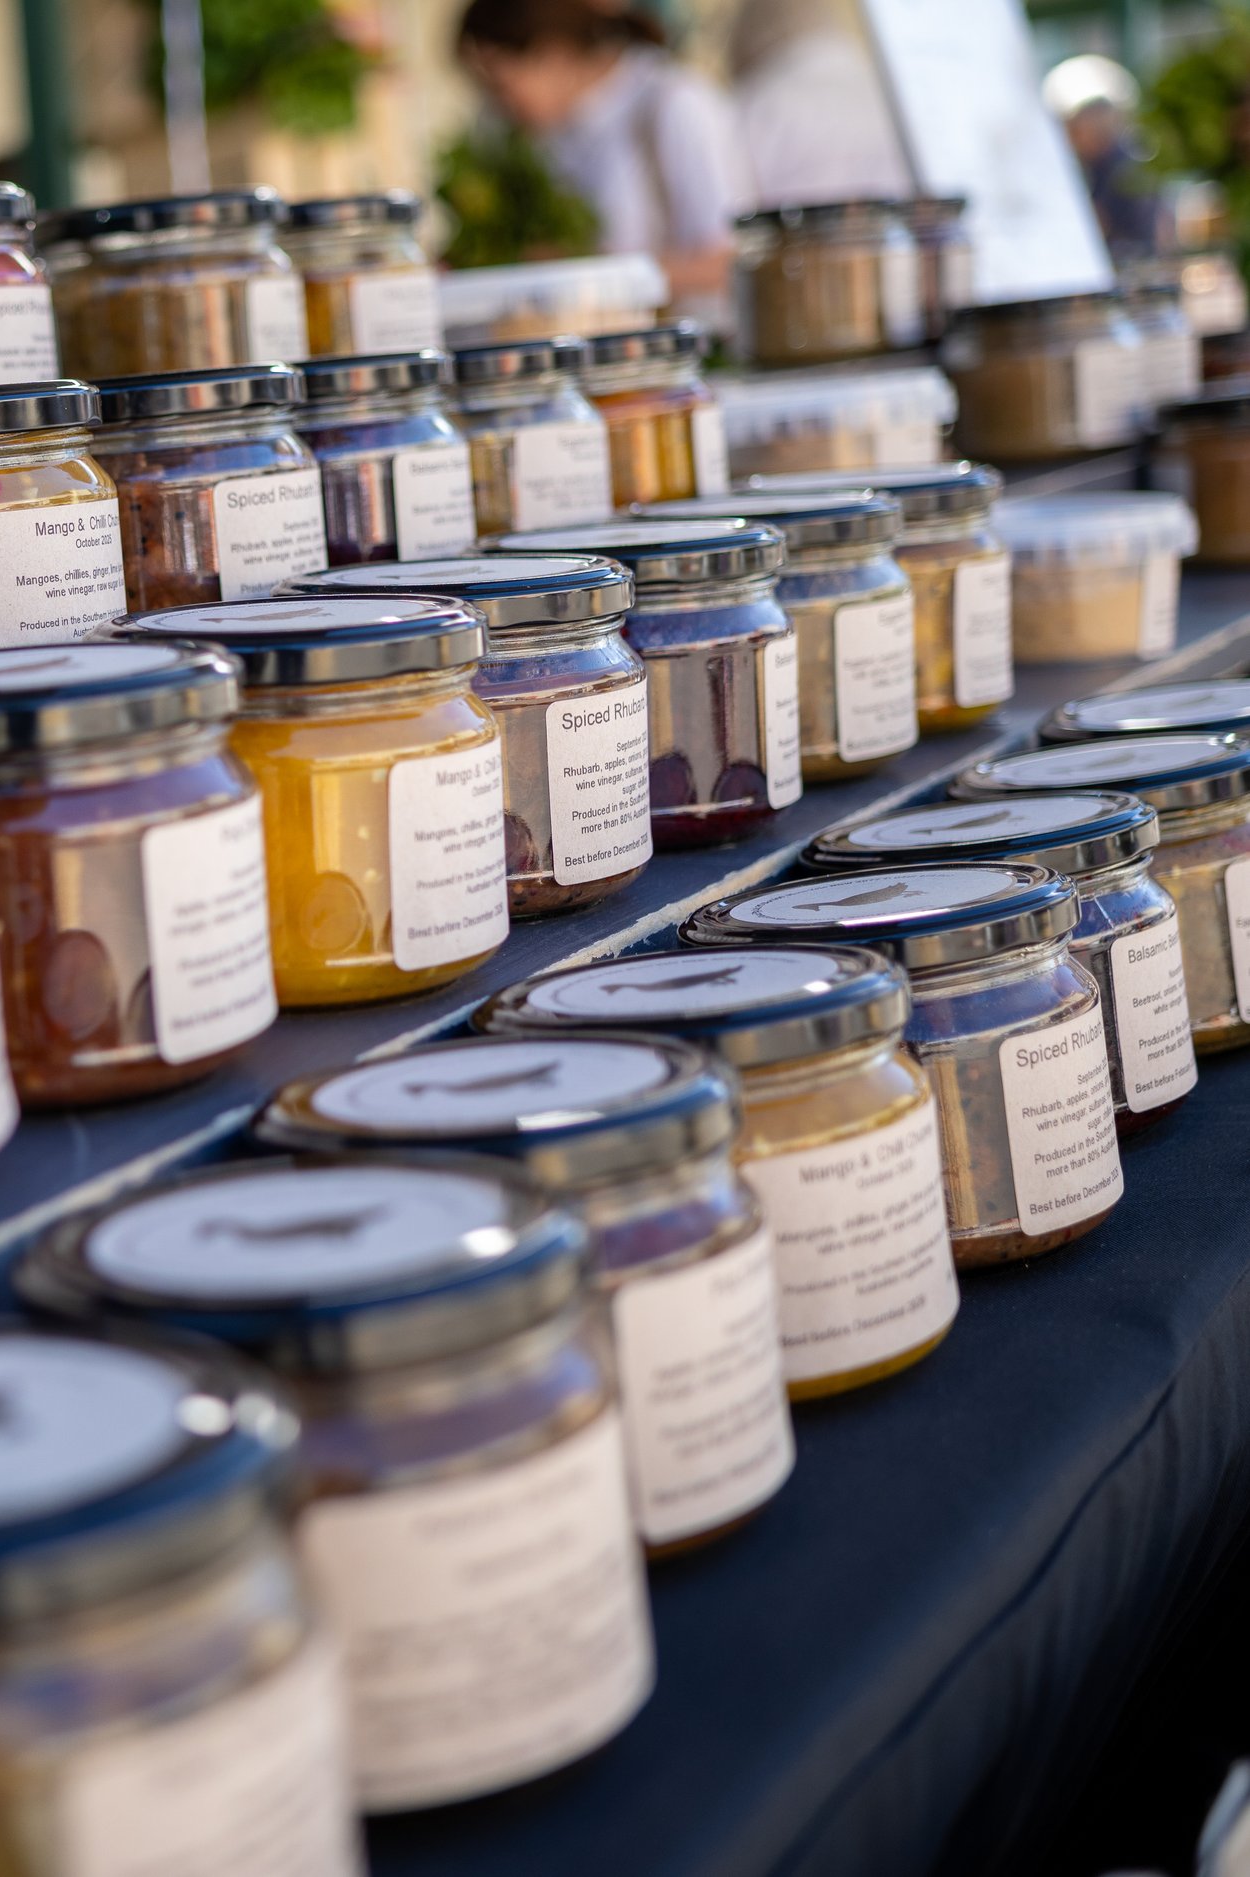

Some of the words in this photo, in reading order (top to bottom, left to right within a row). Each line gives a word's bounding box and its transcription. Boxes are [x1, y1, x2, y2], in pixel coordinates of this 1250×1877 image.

[227, 488, 276, 510] Spiced
[35, 521, 75, 537] Mango
[77, 518, 85, 532] &
[89, 515, 106, 530] Chilli
[75, 537, 100, 549] October
[101, 534, 112, 546] 2025
[16, 573, 63, 587] Mangoes,
[64, 568, 91, 581] chillies,
[92, 565, 110, 580] ginger,
[45, 587, 66, 599] wine
[68, 584, 96, 596] vinegar,
[97, 581, 107, 591] raw
[20, 617, 60, 631] Produced
[61, 616, 69, 626] in
[70, 615, 81, 625] the
[82, 611, 107, 623] Southern
[561, 705, 610, 732] Spiced
[616, 735, 641, 752] September
[436, 766, 472, 787] Mango
[563, 762, 603, 778] Rhubarb,
[604, 757, 627, 772] apples,
[575, 779, 596, 791] wine
[597, 772, 624, 786] vinegar,
[571, 804, 611, 821] Produced
[611, 803, 618, 812] in
[619, 800, 628, 810] the
[581, 823, 602, 835] more
[603, 817, 619, 830] than
[619, 812, 634, 825] 80%
[564, 854, 586, 867] Best
[586, 849, 612, 863] before
[613, 839, 641, 857] December
[1128, 939, 1168, 965] Balsamic
[1132, 990, 1162, 1009] Beetroot,
[1138, 1029, 1170, 1050] Produced
[1016, 1035, 1069, 1070] Spiced
[1147, 1049, 1165, 1062] more
[1135, 1079, 1154, 1095] Best
[1154, 1071, 1175, 1088] before
[1021, 1099, 1065, 1119] Rhubarb,
[1036, 1118, 1059, 1132] wine
[1034, 1144, 1077, 1165] Produced
[1077, 1140, 1085, 1151] in
[1085, 1134, 1095, 1148] the
[799, 1161, 855, 1184] Mango
[1046, 1164, 1069, 1179] more
[1069, 1156, 1087, 1171] than
[1029, 1200, 1053, 1215] Best
[1054, 1192, 1082, 1209] before
[1082, 1174, 1112, 1199] December
